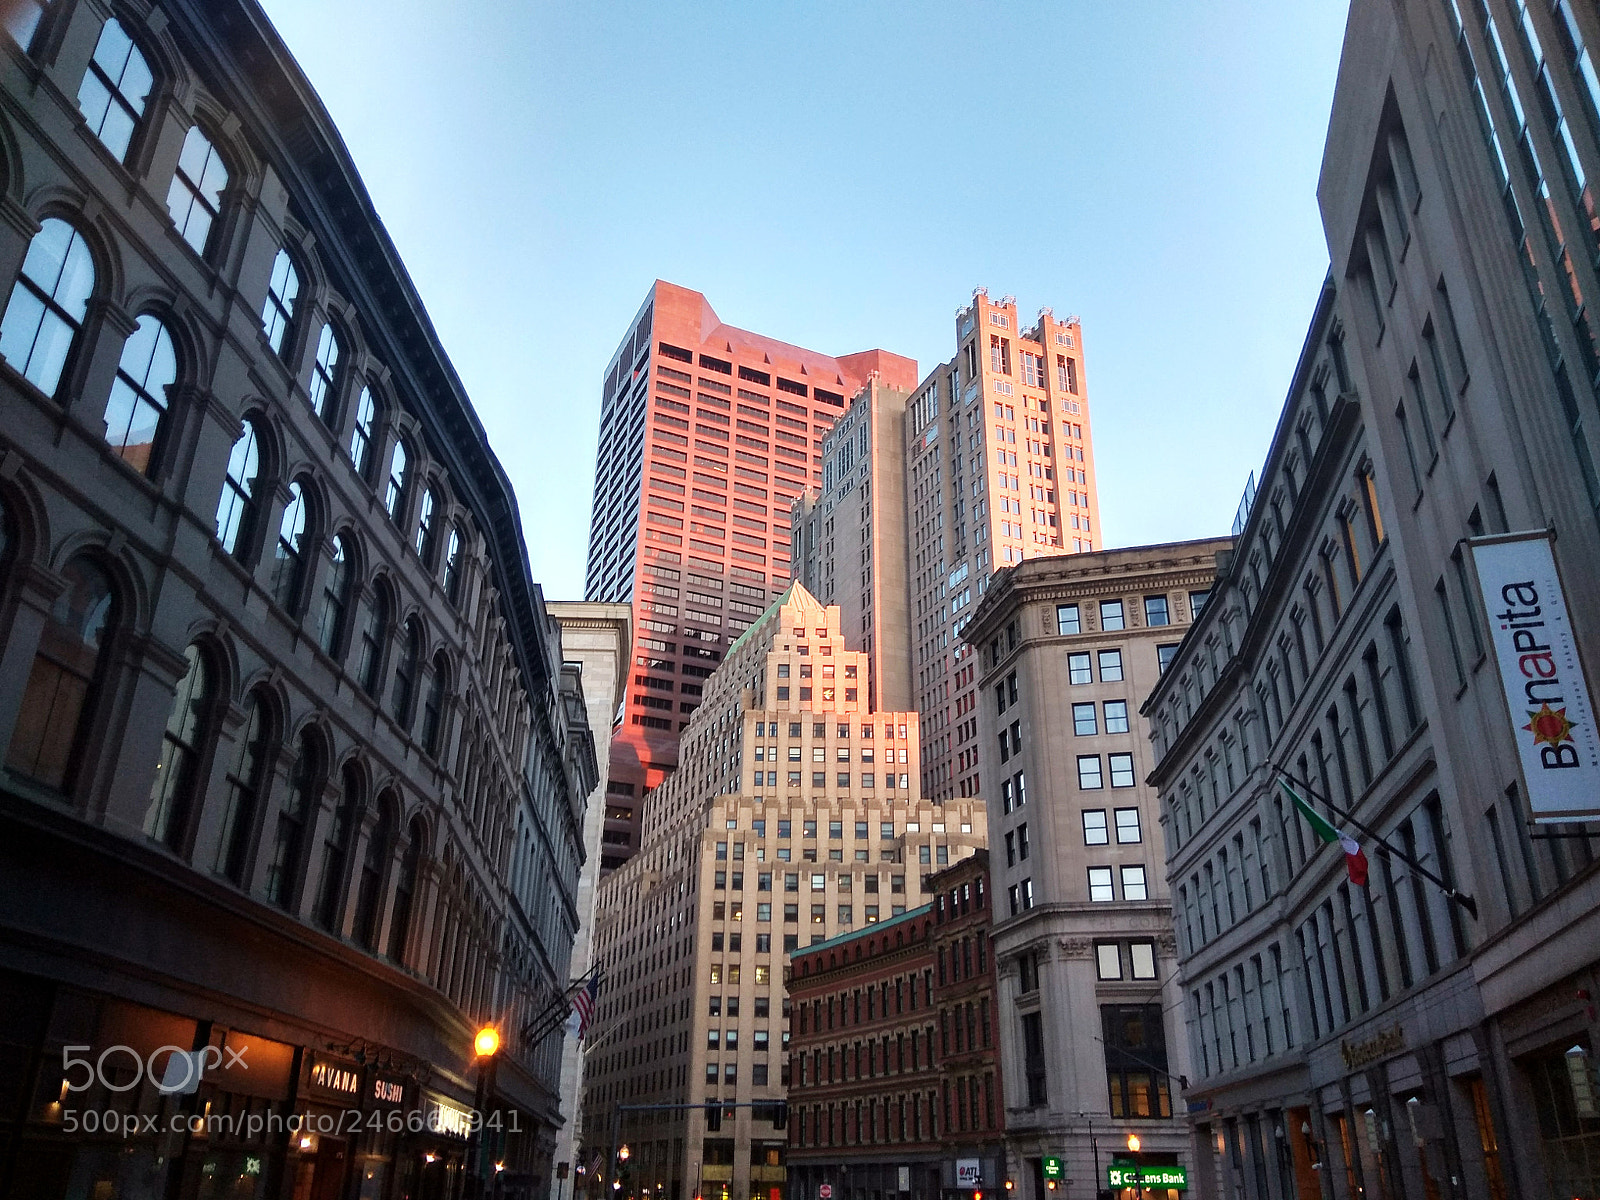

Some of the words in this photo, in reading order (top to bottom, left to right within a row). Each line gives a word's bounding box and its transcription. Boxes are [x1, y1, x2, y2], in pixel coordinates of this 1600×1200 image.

[317, 1065, 358, 1094] AVANA
[374, 1079, 404, 1103] SUSHI
[1123, 1172, 1162, 1184] Citens
[1162, 1172, 1185, 1184] Bank
